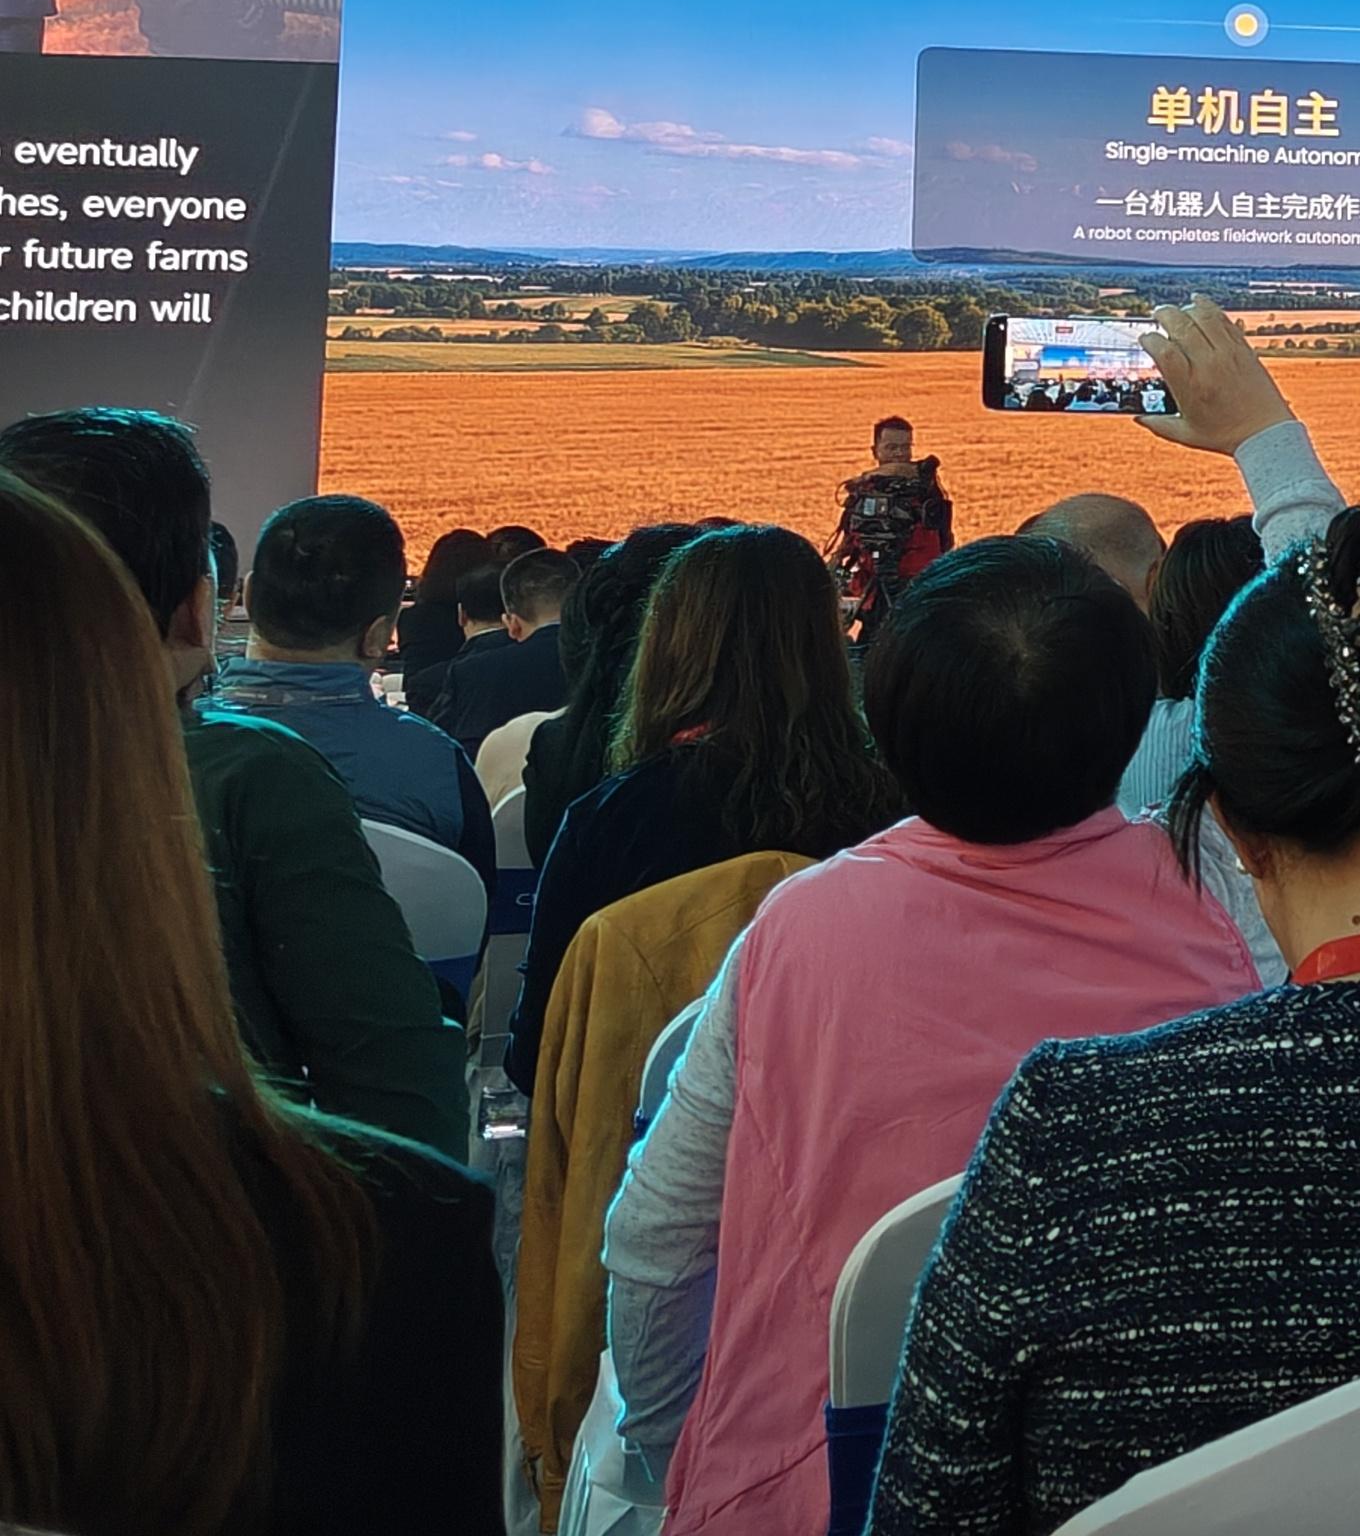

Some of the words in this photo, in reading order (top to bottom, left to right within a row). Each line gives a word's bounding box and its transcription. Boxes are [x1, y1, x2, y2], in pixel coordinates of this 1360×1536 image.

[1147, 86, 1340, 137] 单机自主
[15, 138, 199, 175] eventually
[1105, 142, 1269, 165] Single-machine
[83, 194, 247, 226] everyone
[1073, 226, 1085, 240] A
[1089, 226, 1132, 241] robot
[1135, 228, 1219, 245] completes
[1223, 228, 1292, 244] fieldwork
[23, 239, 133, 269] future
[146, 241, 248, 272] farms
[150, 292, 211, 323] will
